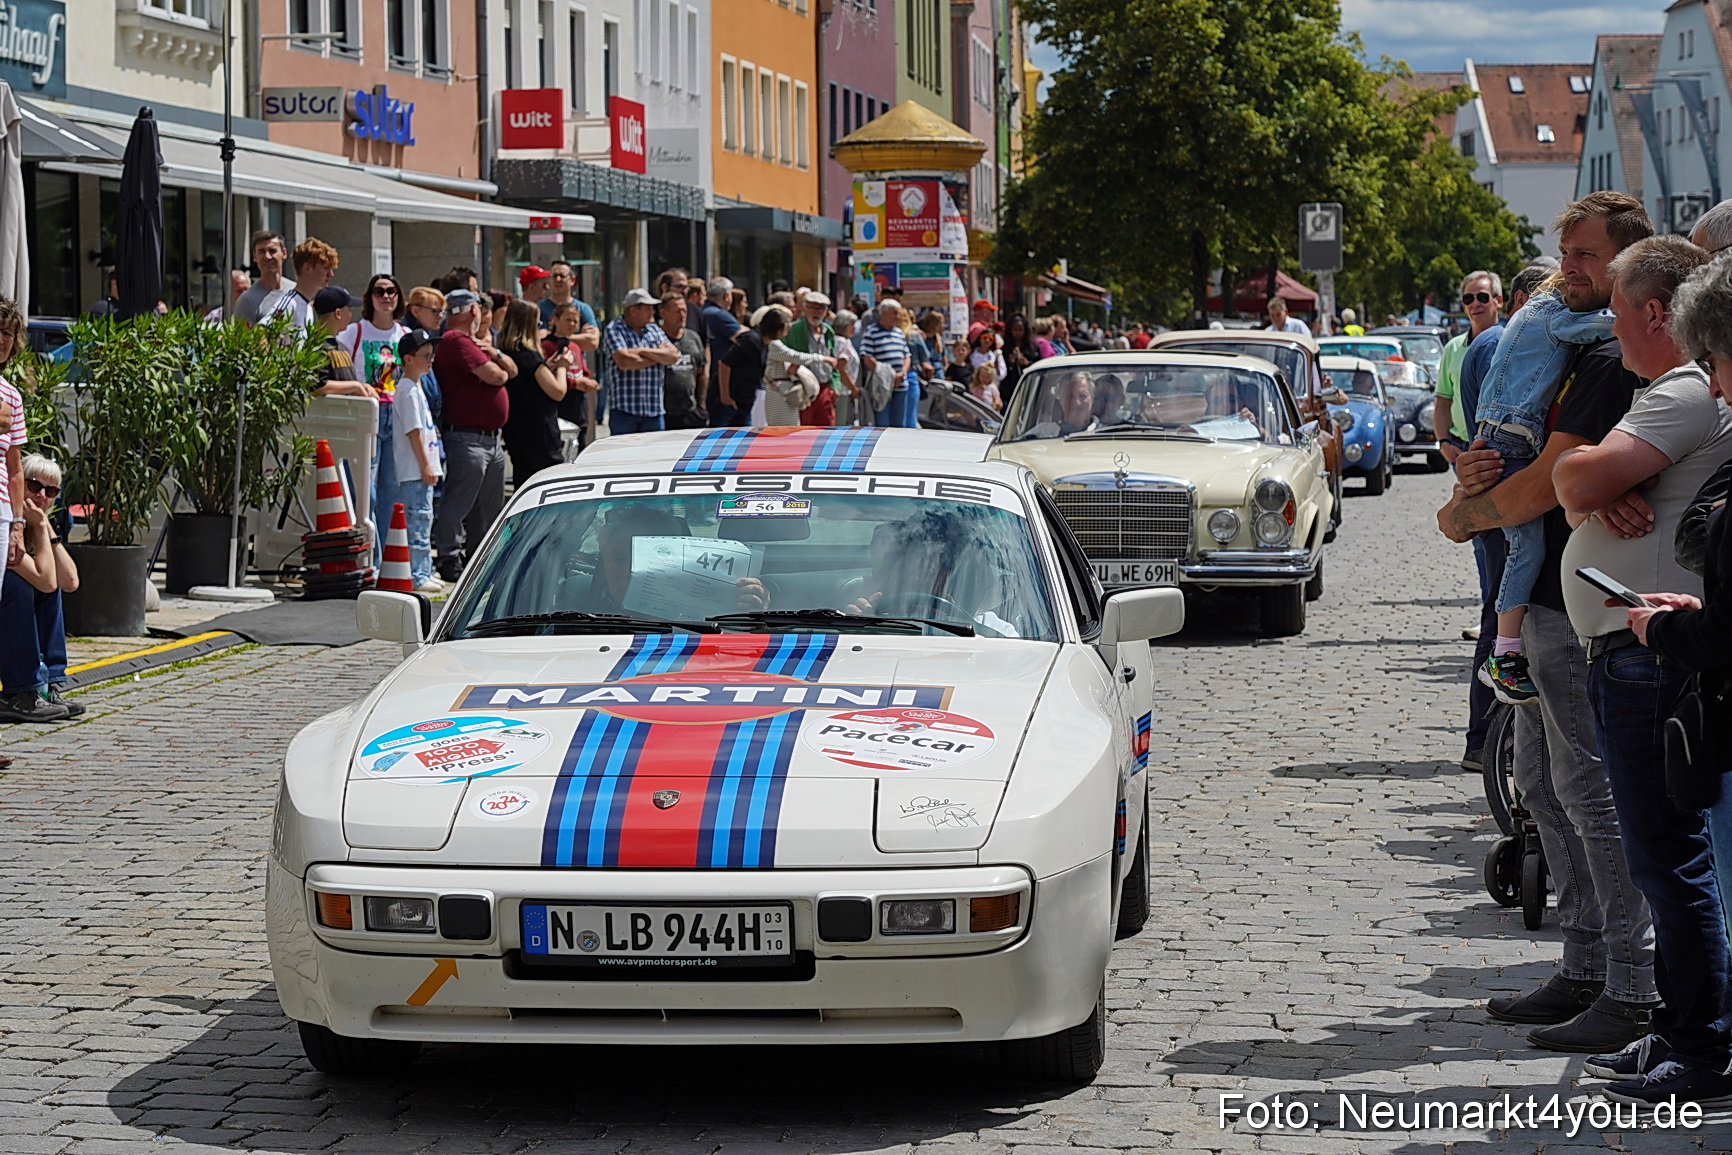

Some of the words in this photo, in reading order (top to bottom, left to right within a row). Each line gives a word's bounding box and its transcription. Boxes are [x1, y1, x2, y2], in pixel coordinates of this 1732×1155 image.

[538, 475, 992, 504] PORSCHE
[754, 503, 775, 512] 56
[696, 551, 735, 576] 471
[1120, 564, 1141, 582] WE
[1144, 564, 1174, 582] 69H
[487, 686, 917, 706] MARTINI
[431, 735, 471, 748] goes
[818, 723, 976, 754] Pacecar
[424, 741, 480, 758] 1000
[428, 746, 492, 766] MIGLIA
[764, 912, 783, 924] 03
[551, 911, 574, 950] N
[605, 912, 654, 951] LB
[663, 912, 761, 952] 944H
[531, 935, 541, 947] D
[766, 938, 784, 950] 10
[598, 957, 718, 967] www.avpmotorsport.de
